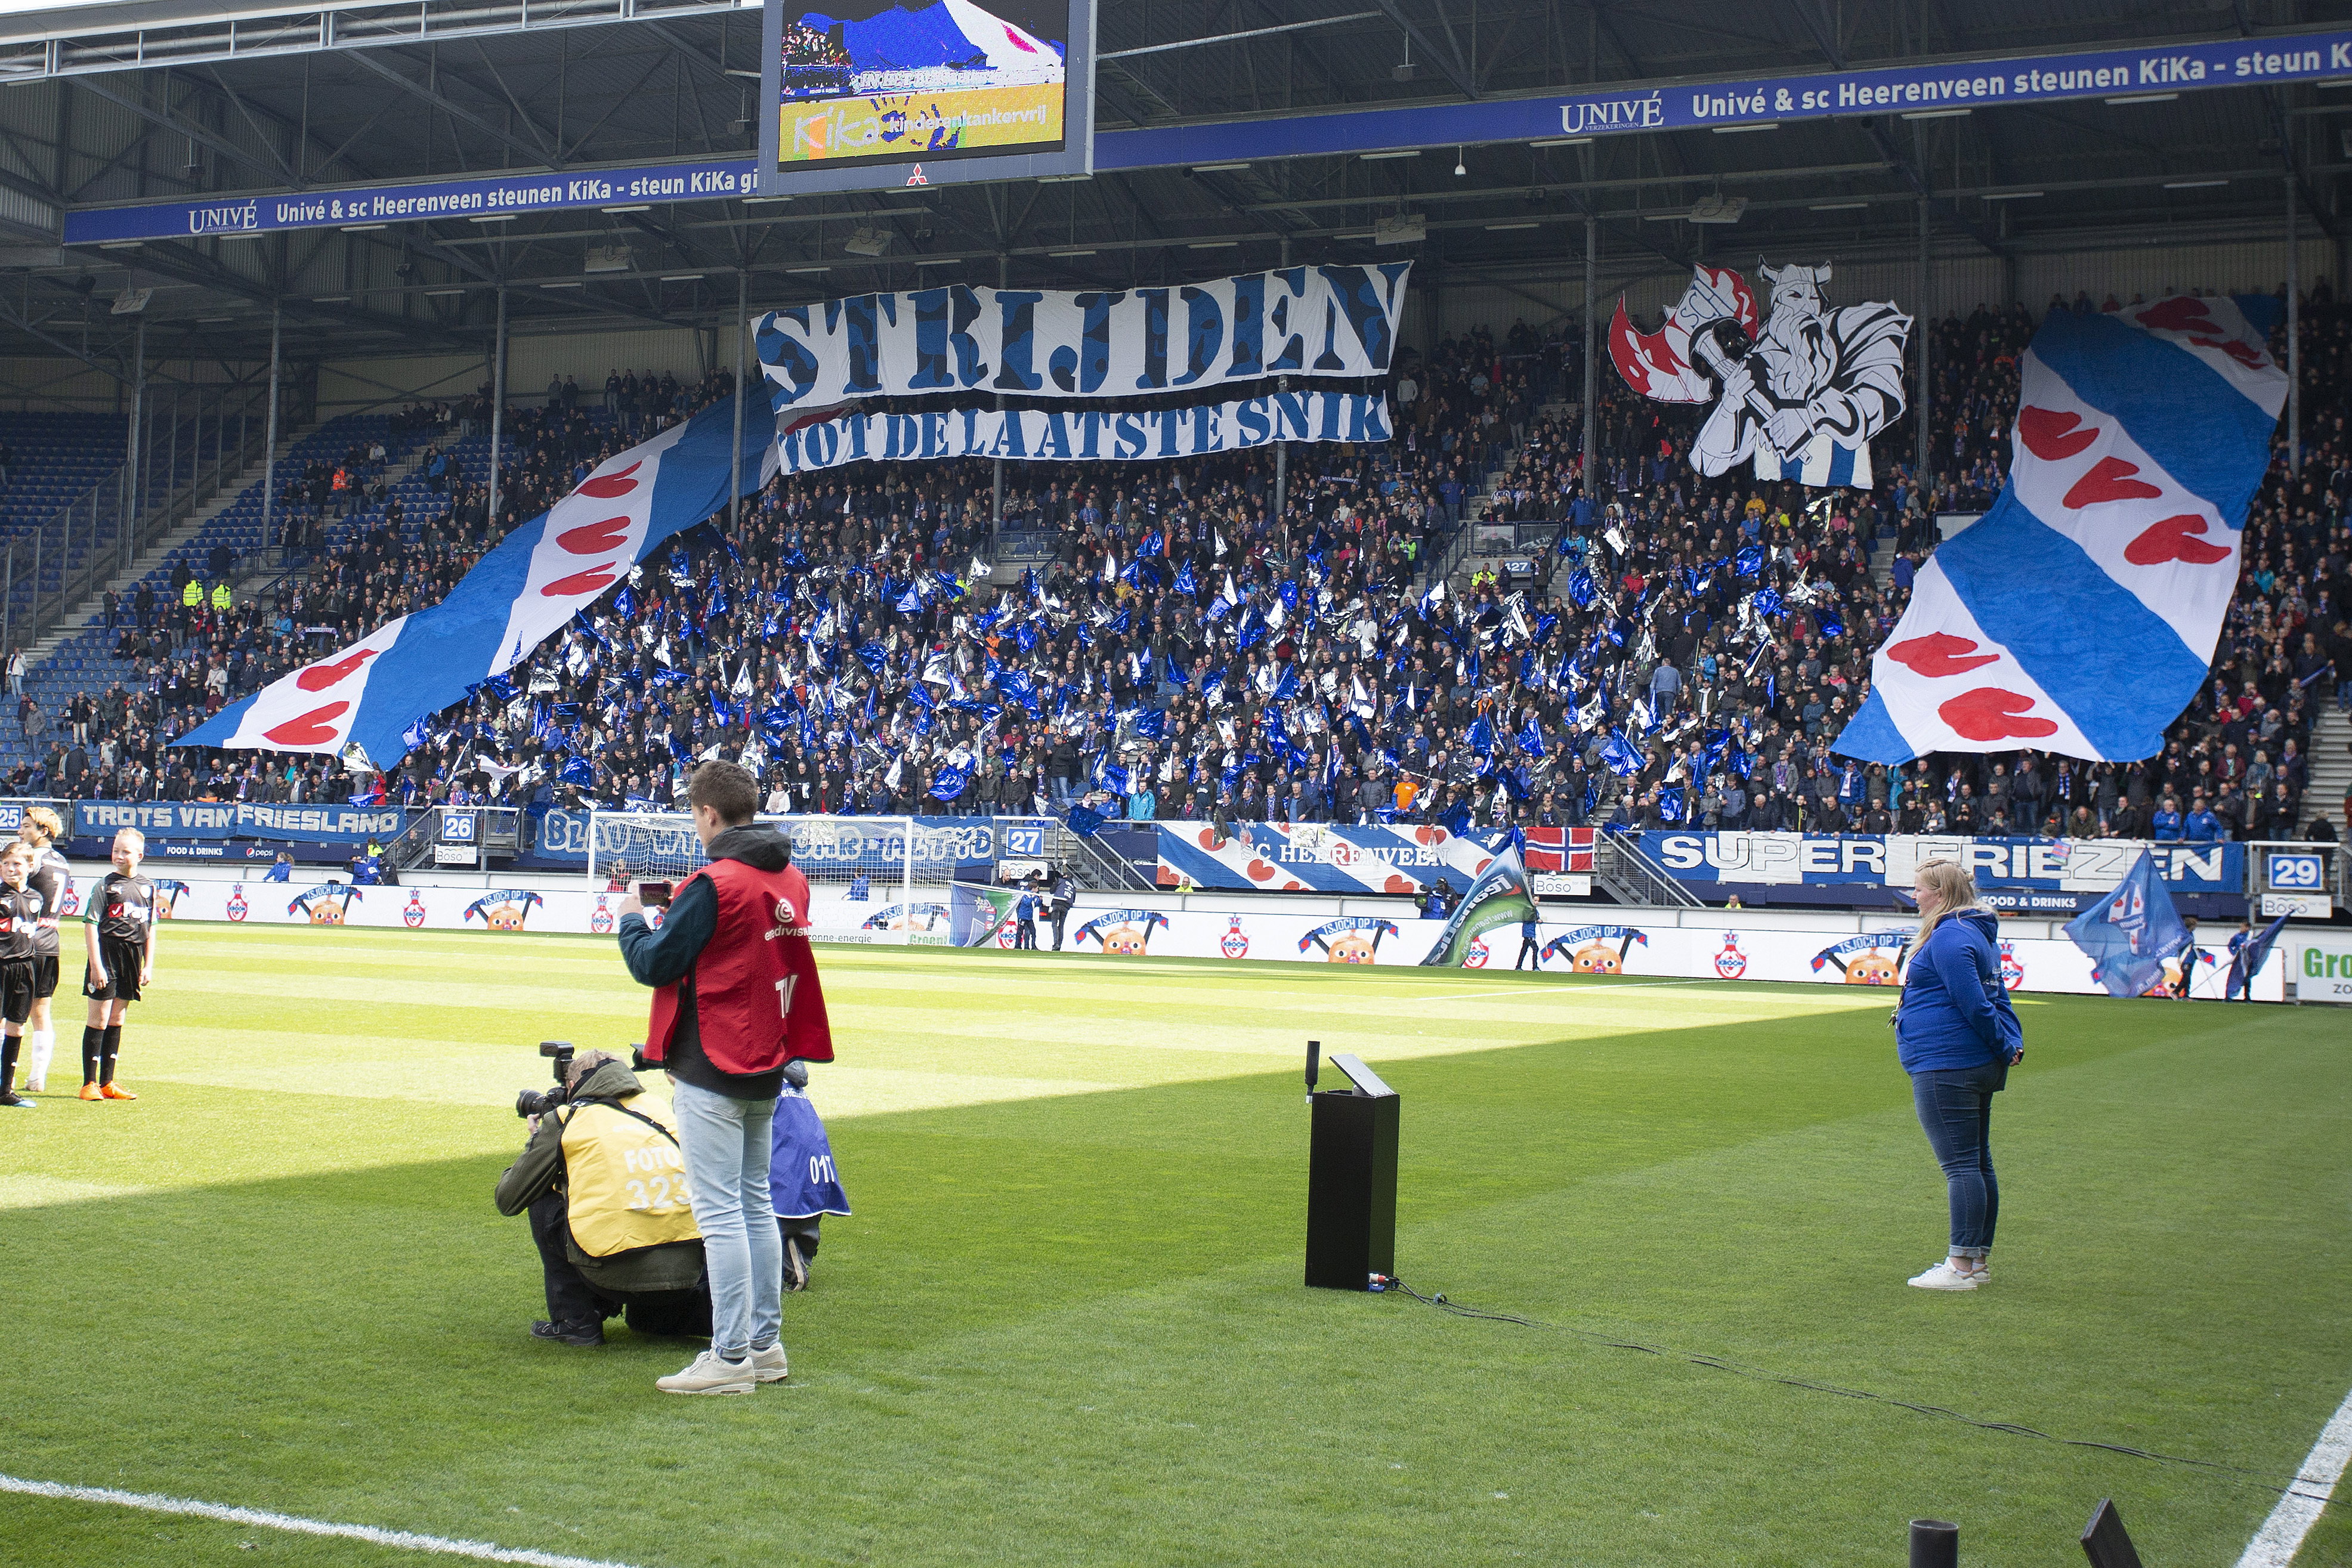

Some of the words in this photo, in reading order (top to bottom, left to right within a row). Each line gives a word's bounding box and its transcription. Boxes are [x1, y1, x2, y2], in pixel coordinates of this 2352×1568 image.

[1693, 88, 1766, 117] Univé
[1775, 88, 1794, 112] &
[1801, 89, 1830, 110] sc
[1839, 76, 2005, 107] Heerenveen
[2014, 67, 2129, 94] steunen
[2139, 57, 2206, 83] KiKa
[2235, 51, 2321, 76] steun
[1559, 90, 1664, 133] UNIVÉ
[1585, 121, 1639, 132] VERZEKERINGEN
[277, 200, 325, 222] Univé
[330, 200, 344, 219] &
[348, 202, 367, 217] sc
[373, 192, 482, 216] Heerenveen
[487, 187, 562, 207] steunen
[568, 180, 611, 201] KiKa
[630, 177, 684, 196] steun
[691, 171, 735, 193] KiKa
[188, 200, 258, 234] UNIVÉ
[756, 262, 1411, 413] STRIJDEN
[84, 805, 173, 828] TROTS
[179, 807, 235, 828] VAN
[237, 804, 399, 834] FRIESLAND
[445, 817, 471, 837] 26
[166, 846, 187, 855] FOOD
[196, 848, 224, 856] DRINKS
[1010, 831, 1040, 852] 27
[255, 849, 273, 858] pepsi
[1241, 843, 1272, 861] SC
[1279, 844, 1449, 867] HEERENVEEN
[1661, 836, 1886, 874] SUPER
[2274, 859, 2317, 885] 29
[307, 885, 332, 900] TSJOCH
[333, 885, 342, 894] OP
[484, 891, 510, 906] TSJOCH
[511, 890, 521, 900] OP
[2019, 897, 2028, 907] &
[2031, 896, 2078, 908] DRINKS
[1098, 911, 1129, 928] TSJOCH
[1130, 910, 1143, 921] OP
[1322, 918, 1356, 935] TSJOCH
[1358, 917, 1371, 929] OP
[1565, 926, 1602, 944] TSJOCH
[1604, 926, 1617, 936] OP
[1840, 935, 1877, 954] TSJOCH
[1879, 935, 1893, 947] OP
[775, 975, 798, 1019] TV
[623, 1146, 680, 1173] FOTO
